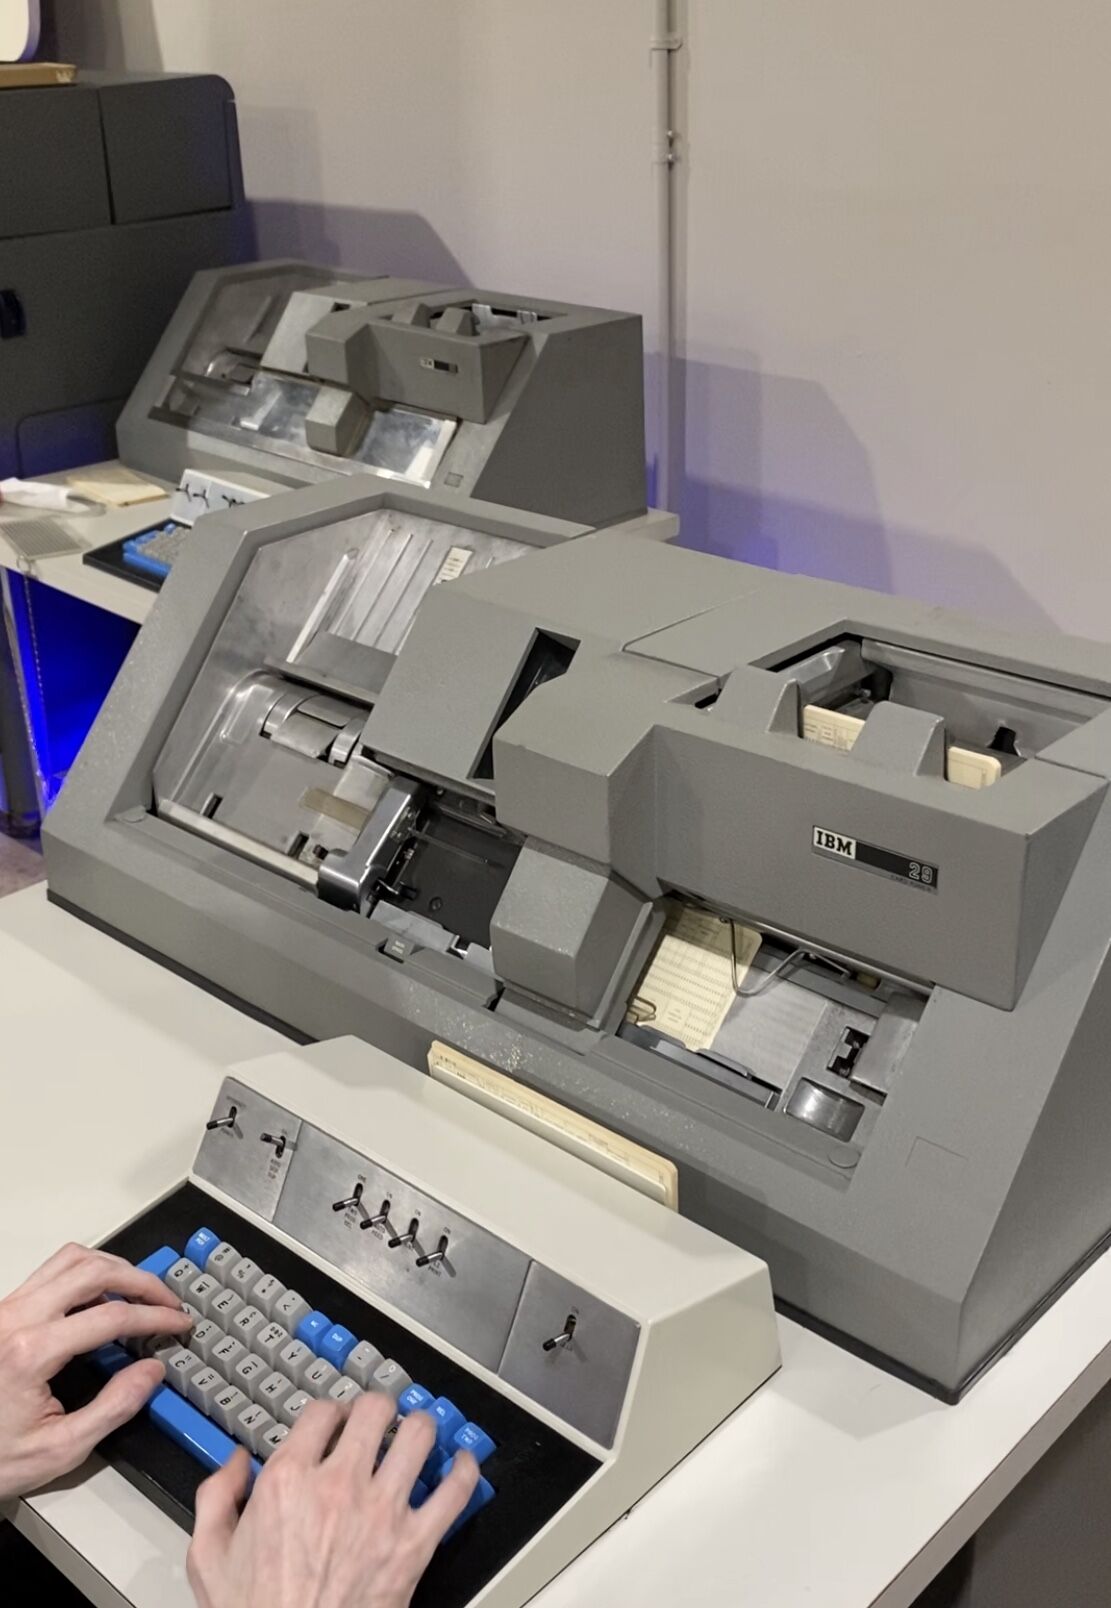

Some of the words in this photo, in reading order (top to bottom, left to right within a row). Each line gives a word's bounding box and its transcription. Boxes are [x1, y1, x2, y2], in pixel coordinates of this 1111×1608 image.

[815, 829, 853, 856] IBM
[908, 862, 934, 884] 29
[175, 1268, 184, 1278] Q
[218, 1300, 229, 1310] E
[239, 1316, 250, 1327] R
[195, 1329, 207, 1339] D
[264, 1334, 275, 1343] T
[217, 1347, 230, 1357] F
[287, 1351, 298, 1360] Y
[174, 1358, 186, 1369] C
[241, 1365, 253, 1375] G
[311, 1370, 322, 1380] U
[197, 1376, 209, 1386] V
[265, 1383, 277, 1394] H
[219, 1395, 232, 1406] B
[243, 1414, 257, 1425] N
[268, 1433, 282, 1445] M
